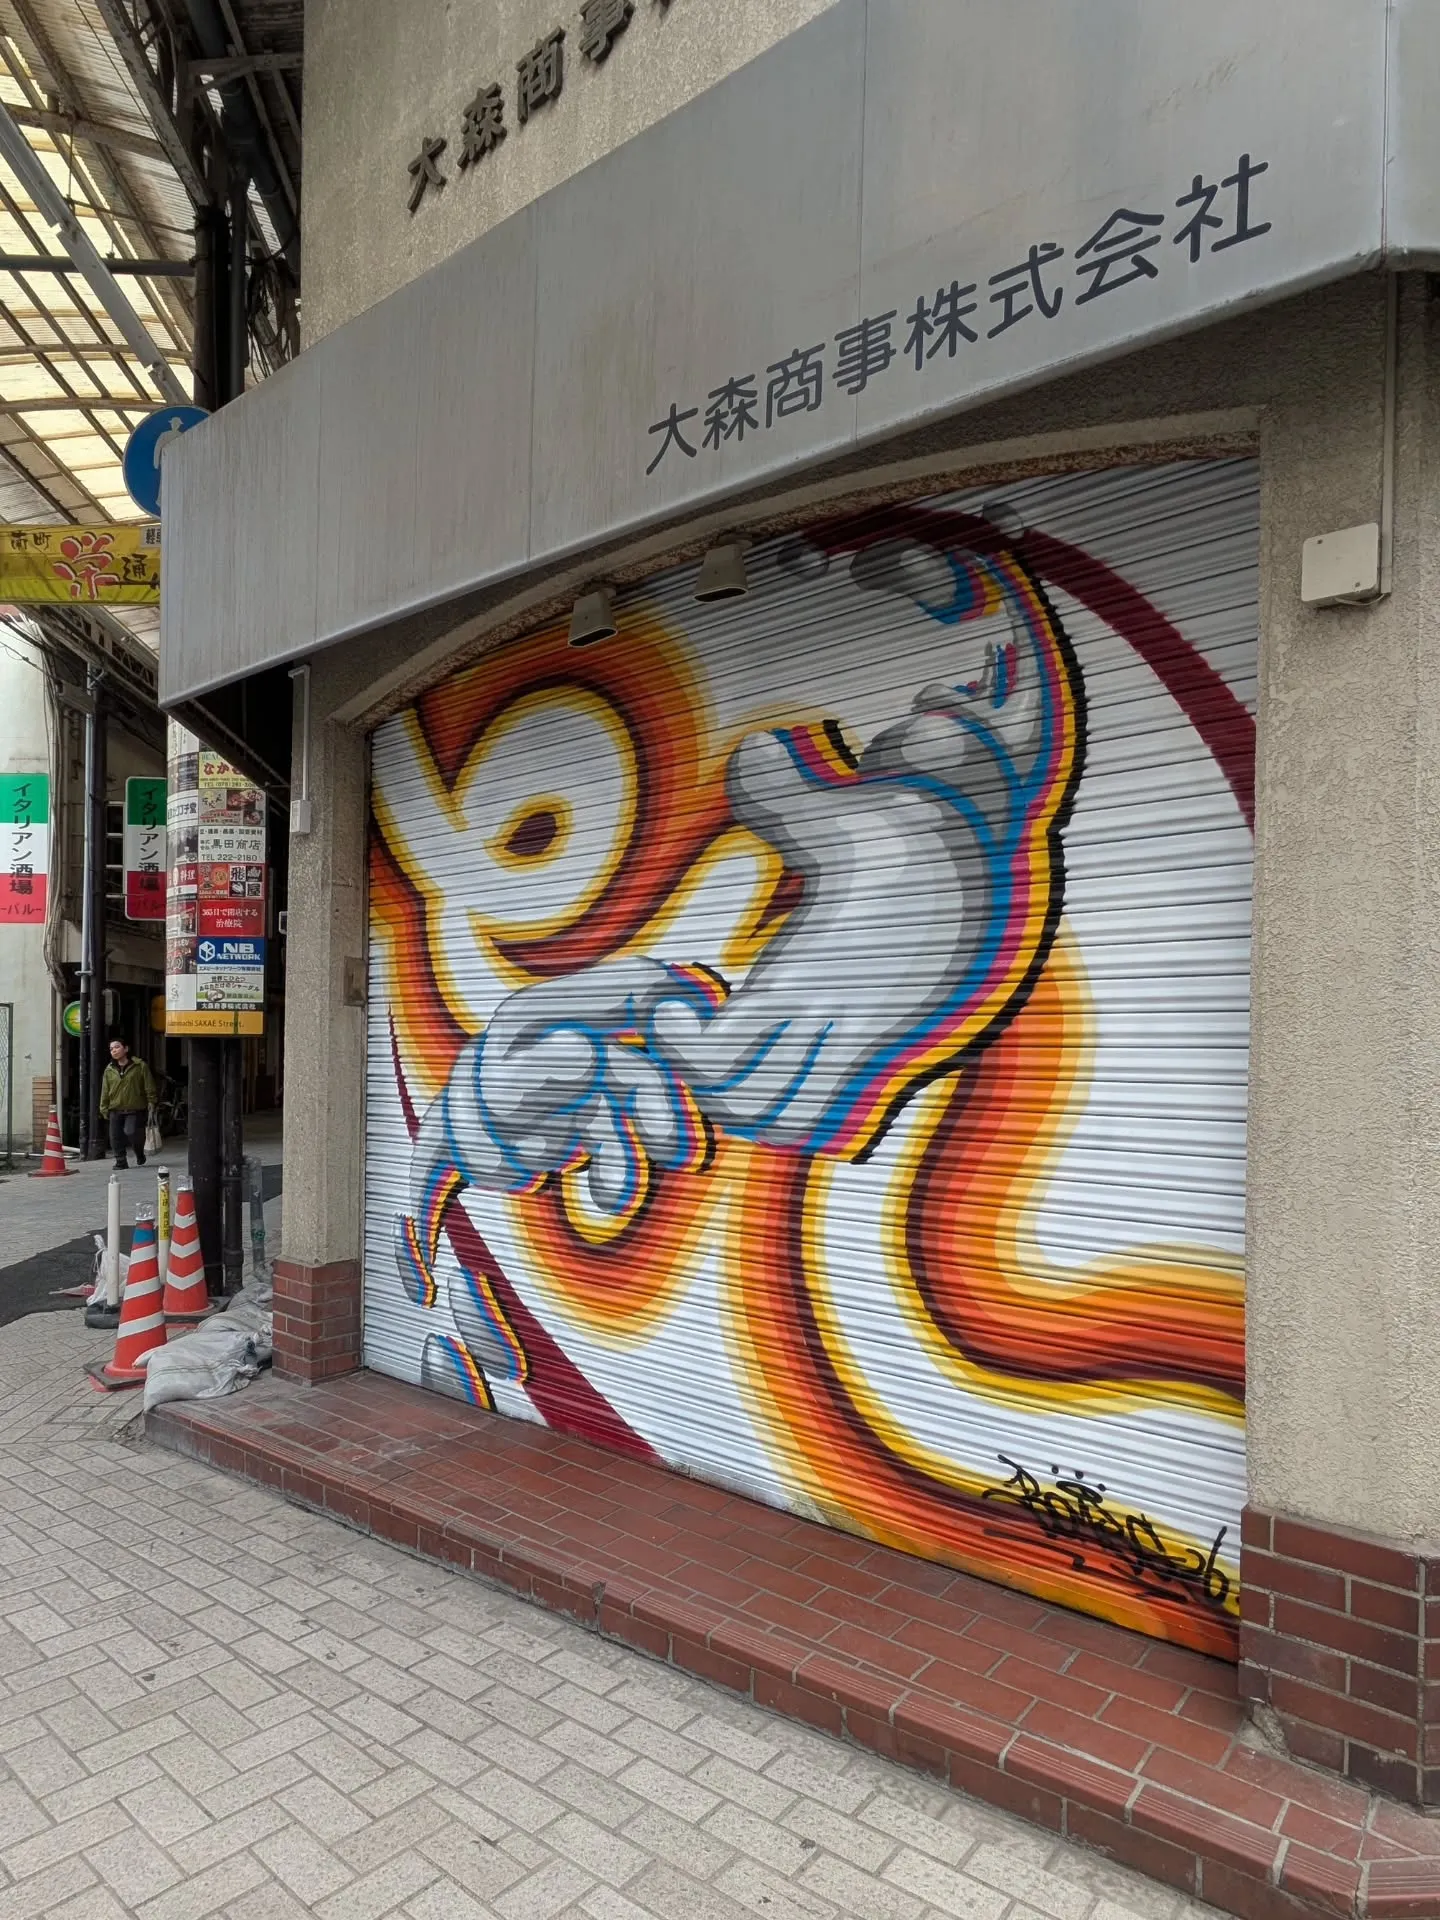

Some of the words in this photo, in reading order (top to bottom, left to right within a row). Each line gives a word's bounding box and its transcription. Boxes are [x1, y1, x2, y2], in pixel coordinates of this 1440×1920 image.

[407, 0, 670, 214] 大森商事
[645, 152, 1273, 476] 大森商事株式会社
[9, 783, 34, 895] イタリアン酒場
[139, 787, 160, 892] イタリアン酒場
[217, 953, 261, 961] NETWORK
[223, 942, 254, 954] NB
[194, 1019, 217, 1027] SAKAE
